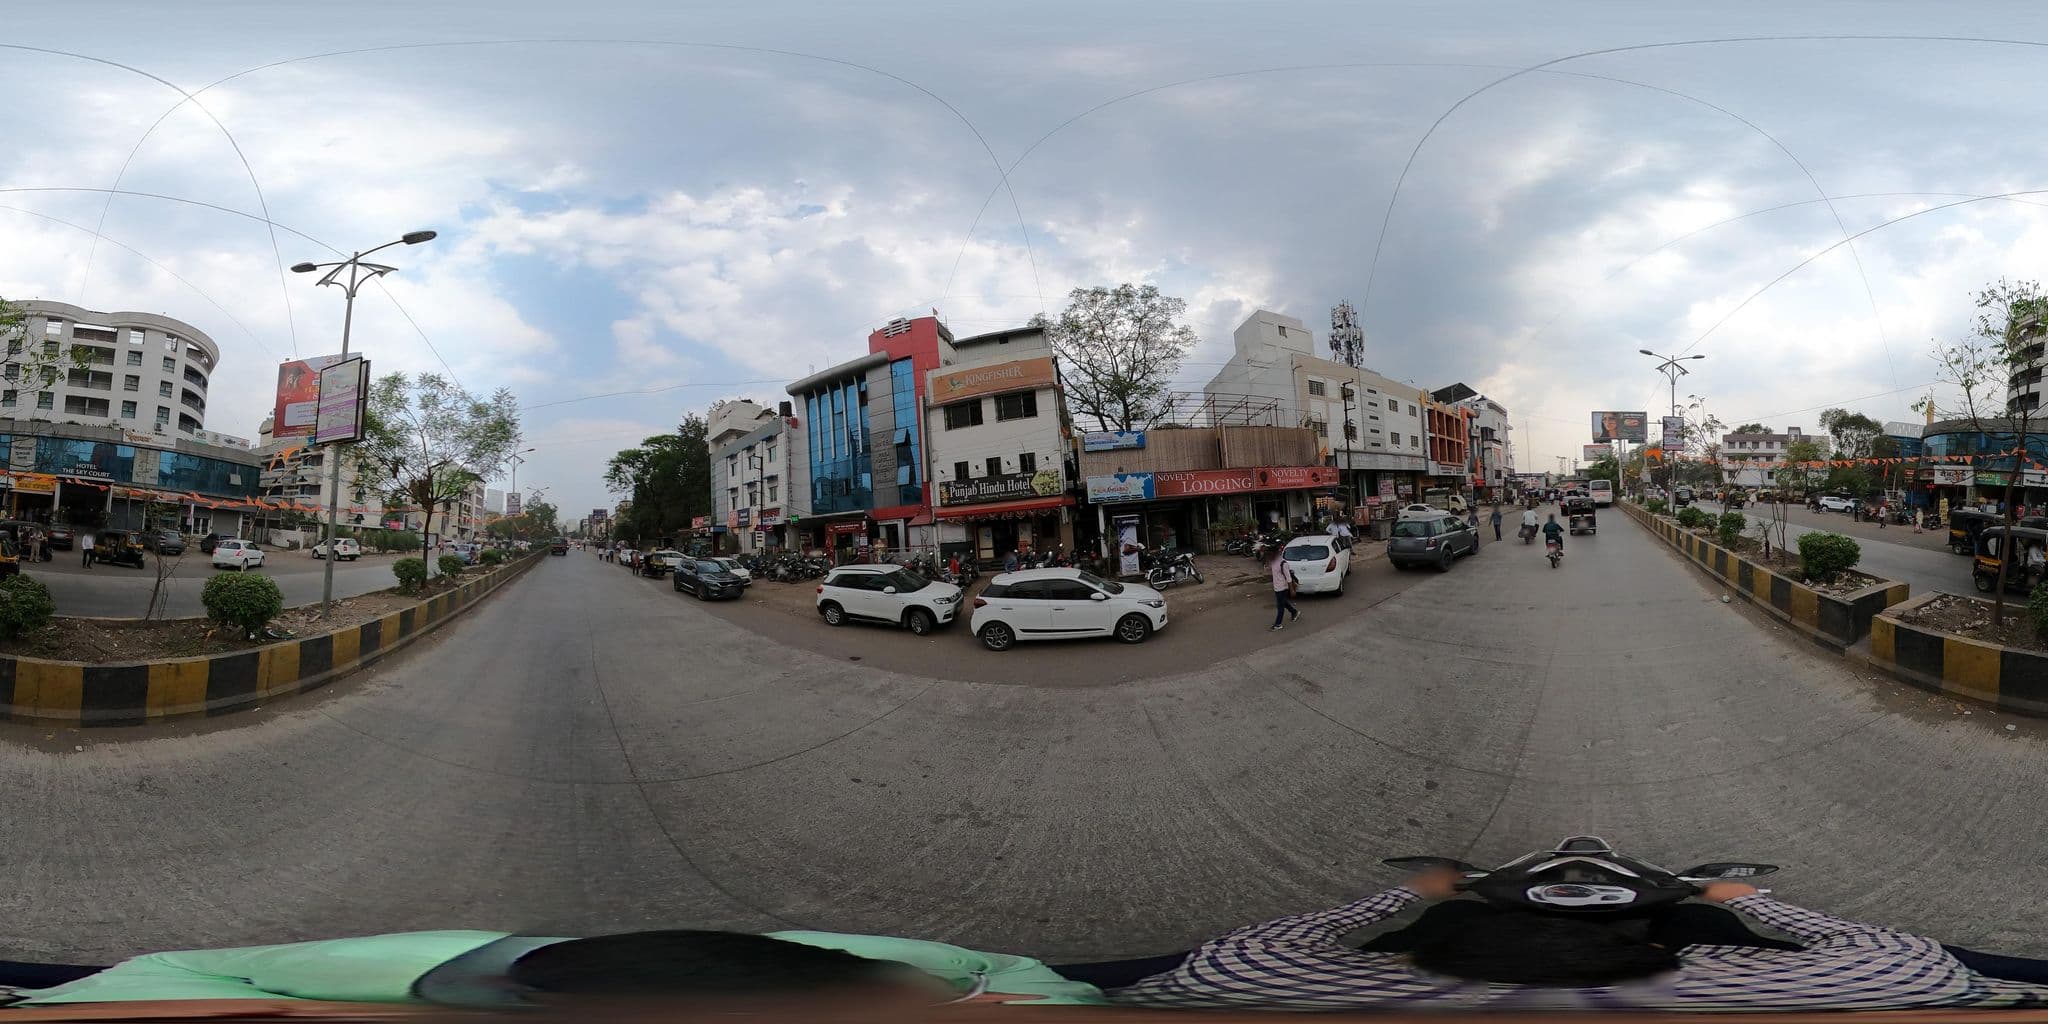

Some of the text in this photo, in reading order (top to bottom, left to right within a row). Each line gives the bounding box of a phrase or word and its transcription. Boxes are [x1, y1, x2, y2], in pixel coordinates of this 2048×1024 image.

[965, 367, 1023, 386] KINGFISHER
[76, 468, 88, 476] SKY
[88, 470, 111, 478] COURT
[1157, 473, 1196, 482] NOVELTY
[1271, 469, 1309, 478] NOVELTY
[949, 483, 978, 499] Punjab
[979, 481, 1006, 495] Hindu
[1007, 478, 1031, 492] Hotel
[1182, 477, 1252, 493] LODGING
